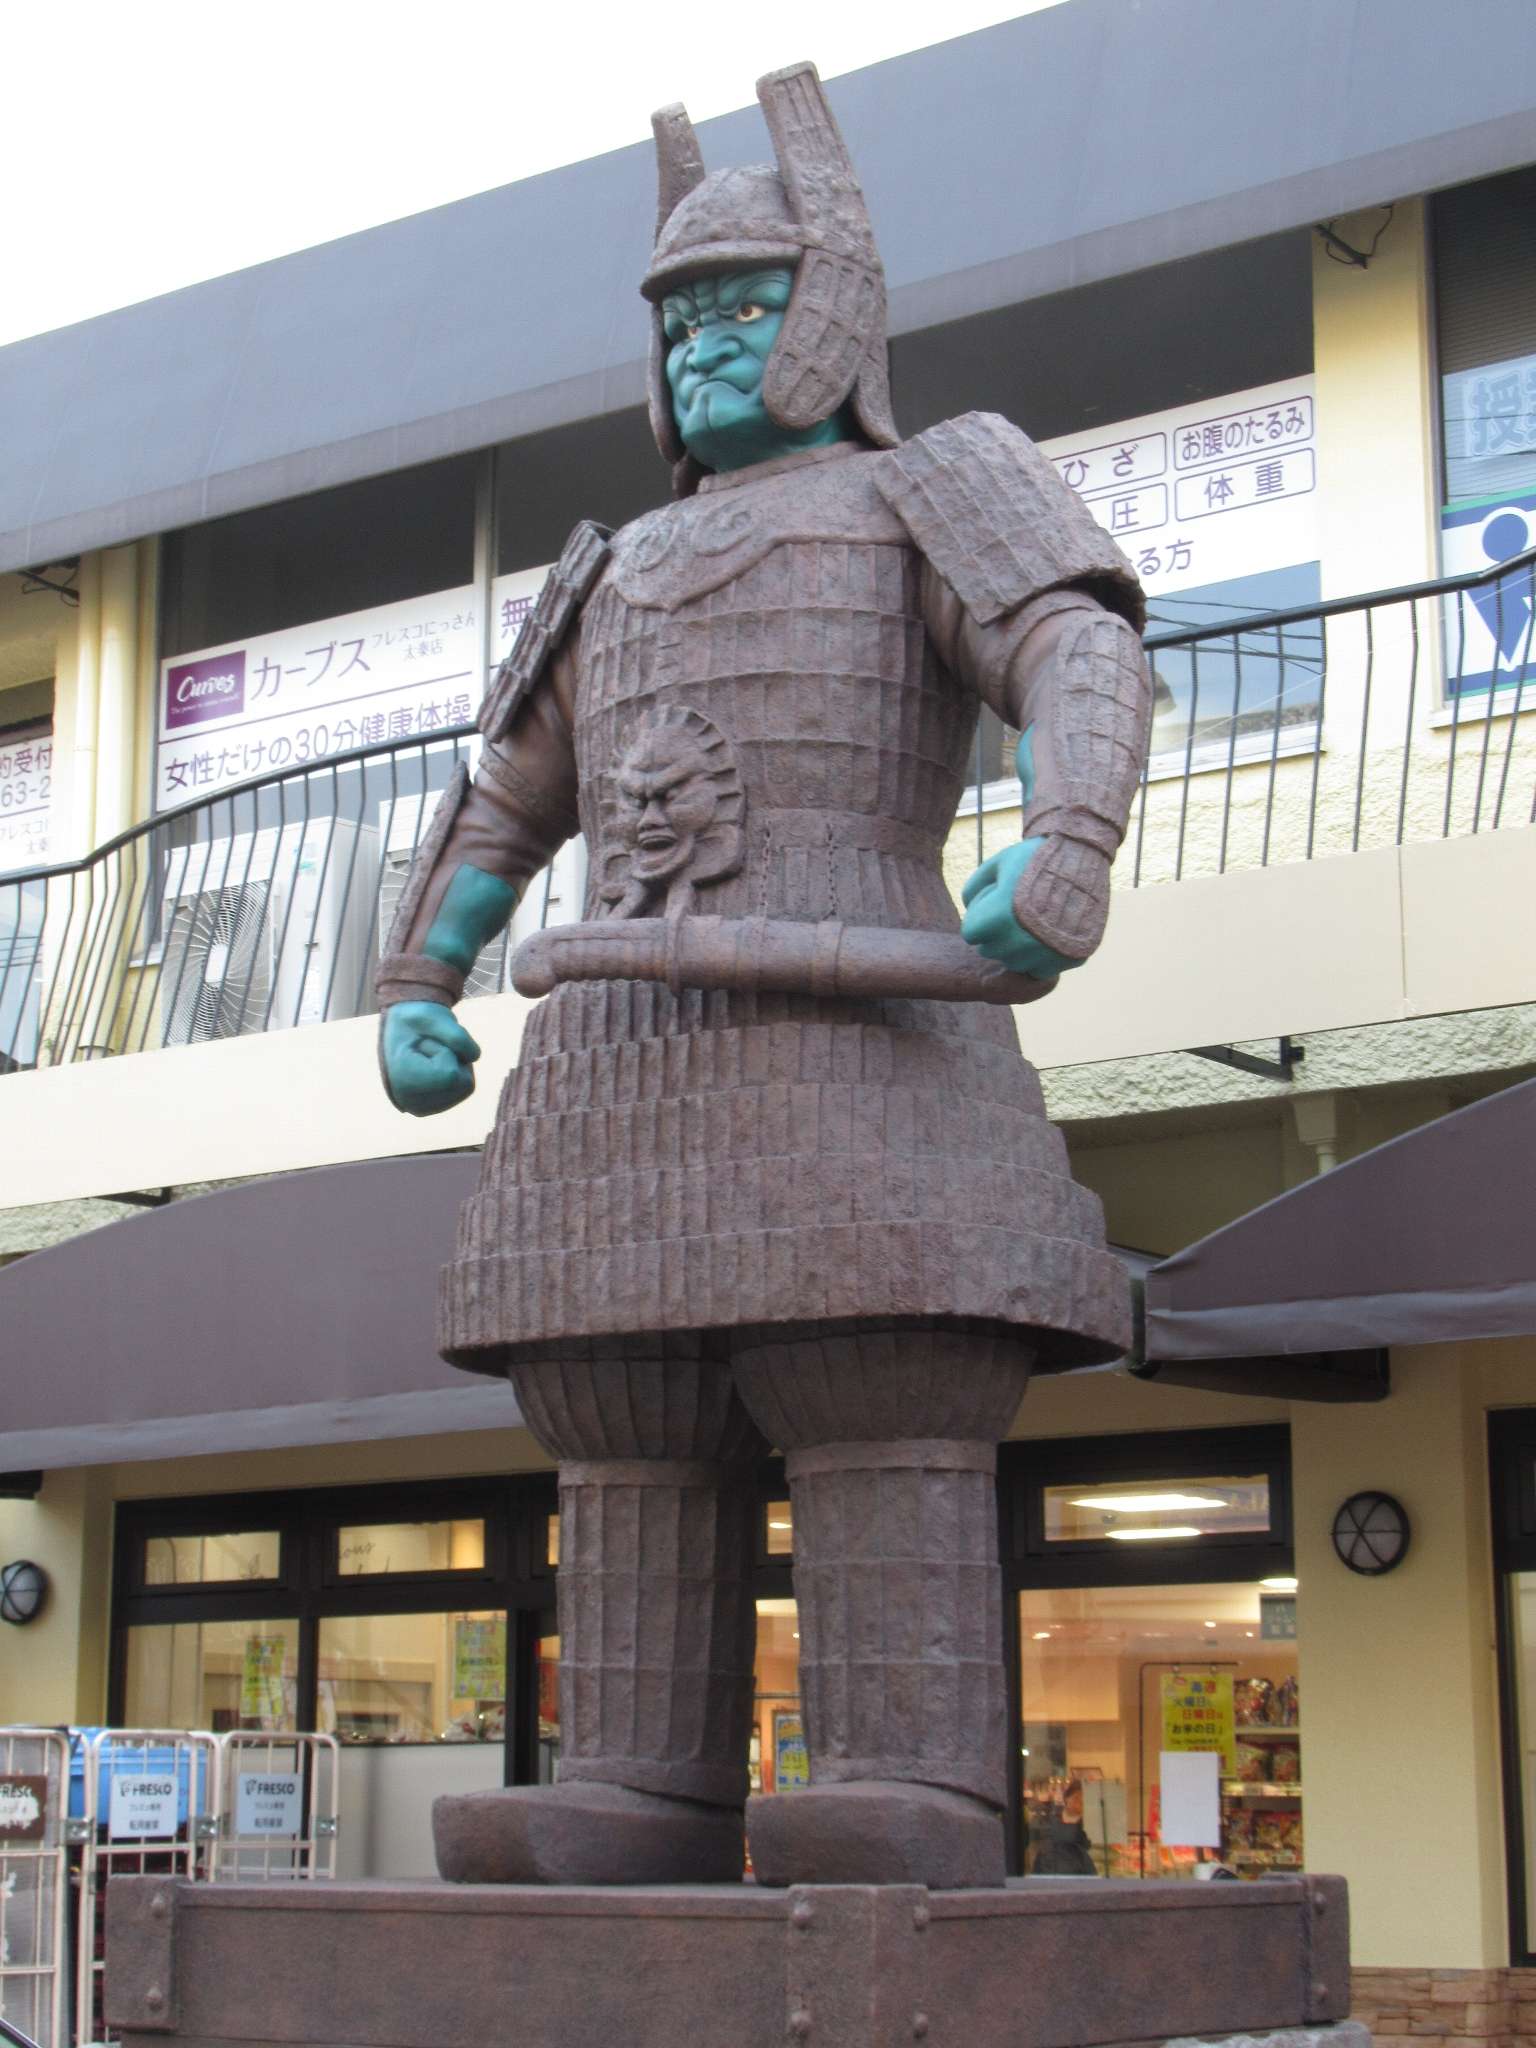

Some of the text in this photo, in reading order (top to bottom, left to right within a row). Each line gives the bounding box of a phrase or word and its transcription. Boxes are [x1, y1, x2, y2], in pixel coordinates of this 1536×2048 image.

[1181, 406, 1306, 462] お腹のたるみ
[1203, 460, 1285, 509] 体重
[1110, 495, 1140, 531] 圧
[176, 673, 236, 703] Curves
[250, 638, 371, 701] カーブス
[164, 693, 472, 792] 女性だけの30分健康体操
[132, 1783, 173, 1796] FRESCO
[257, 1782, 296, 1796] FRESCO
